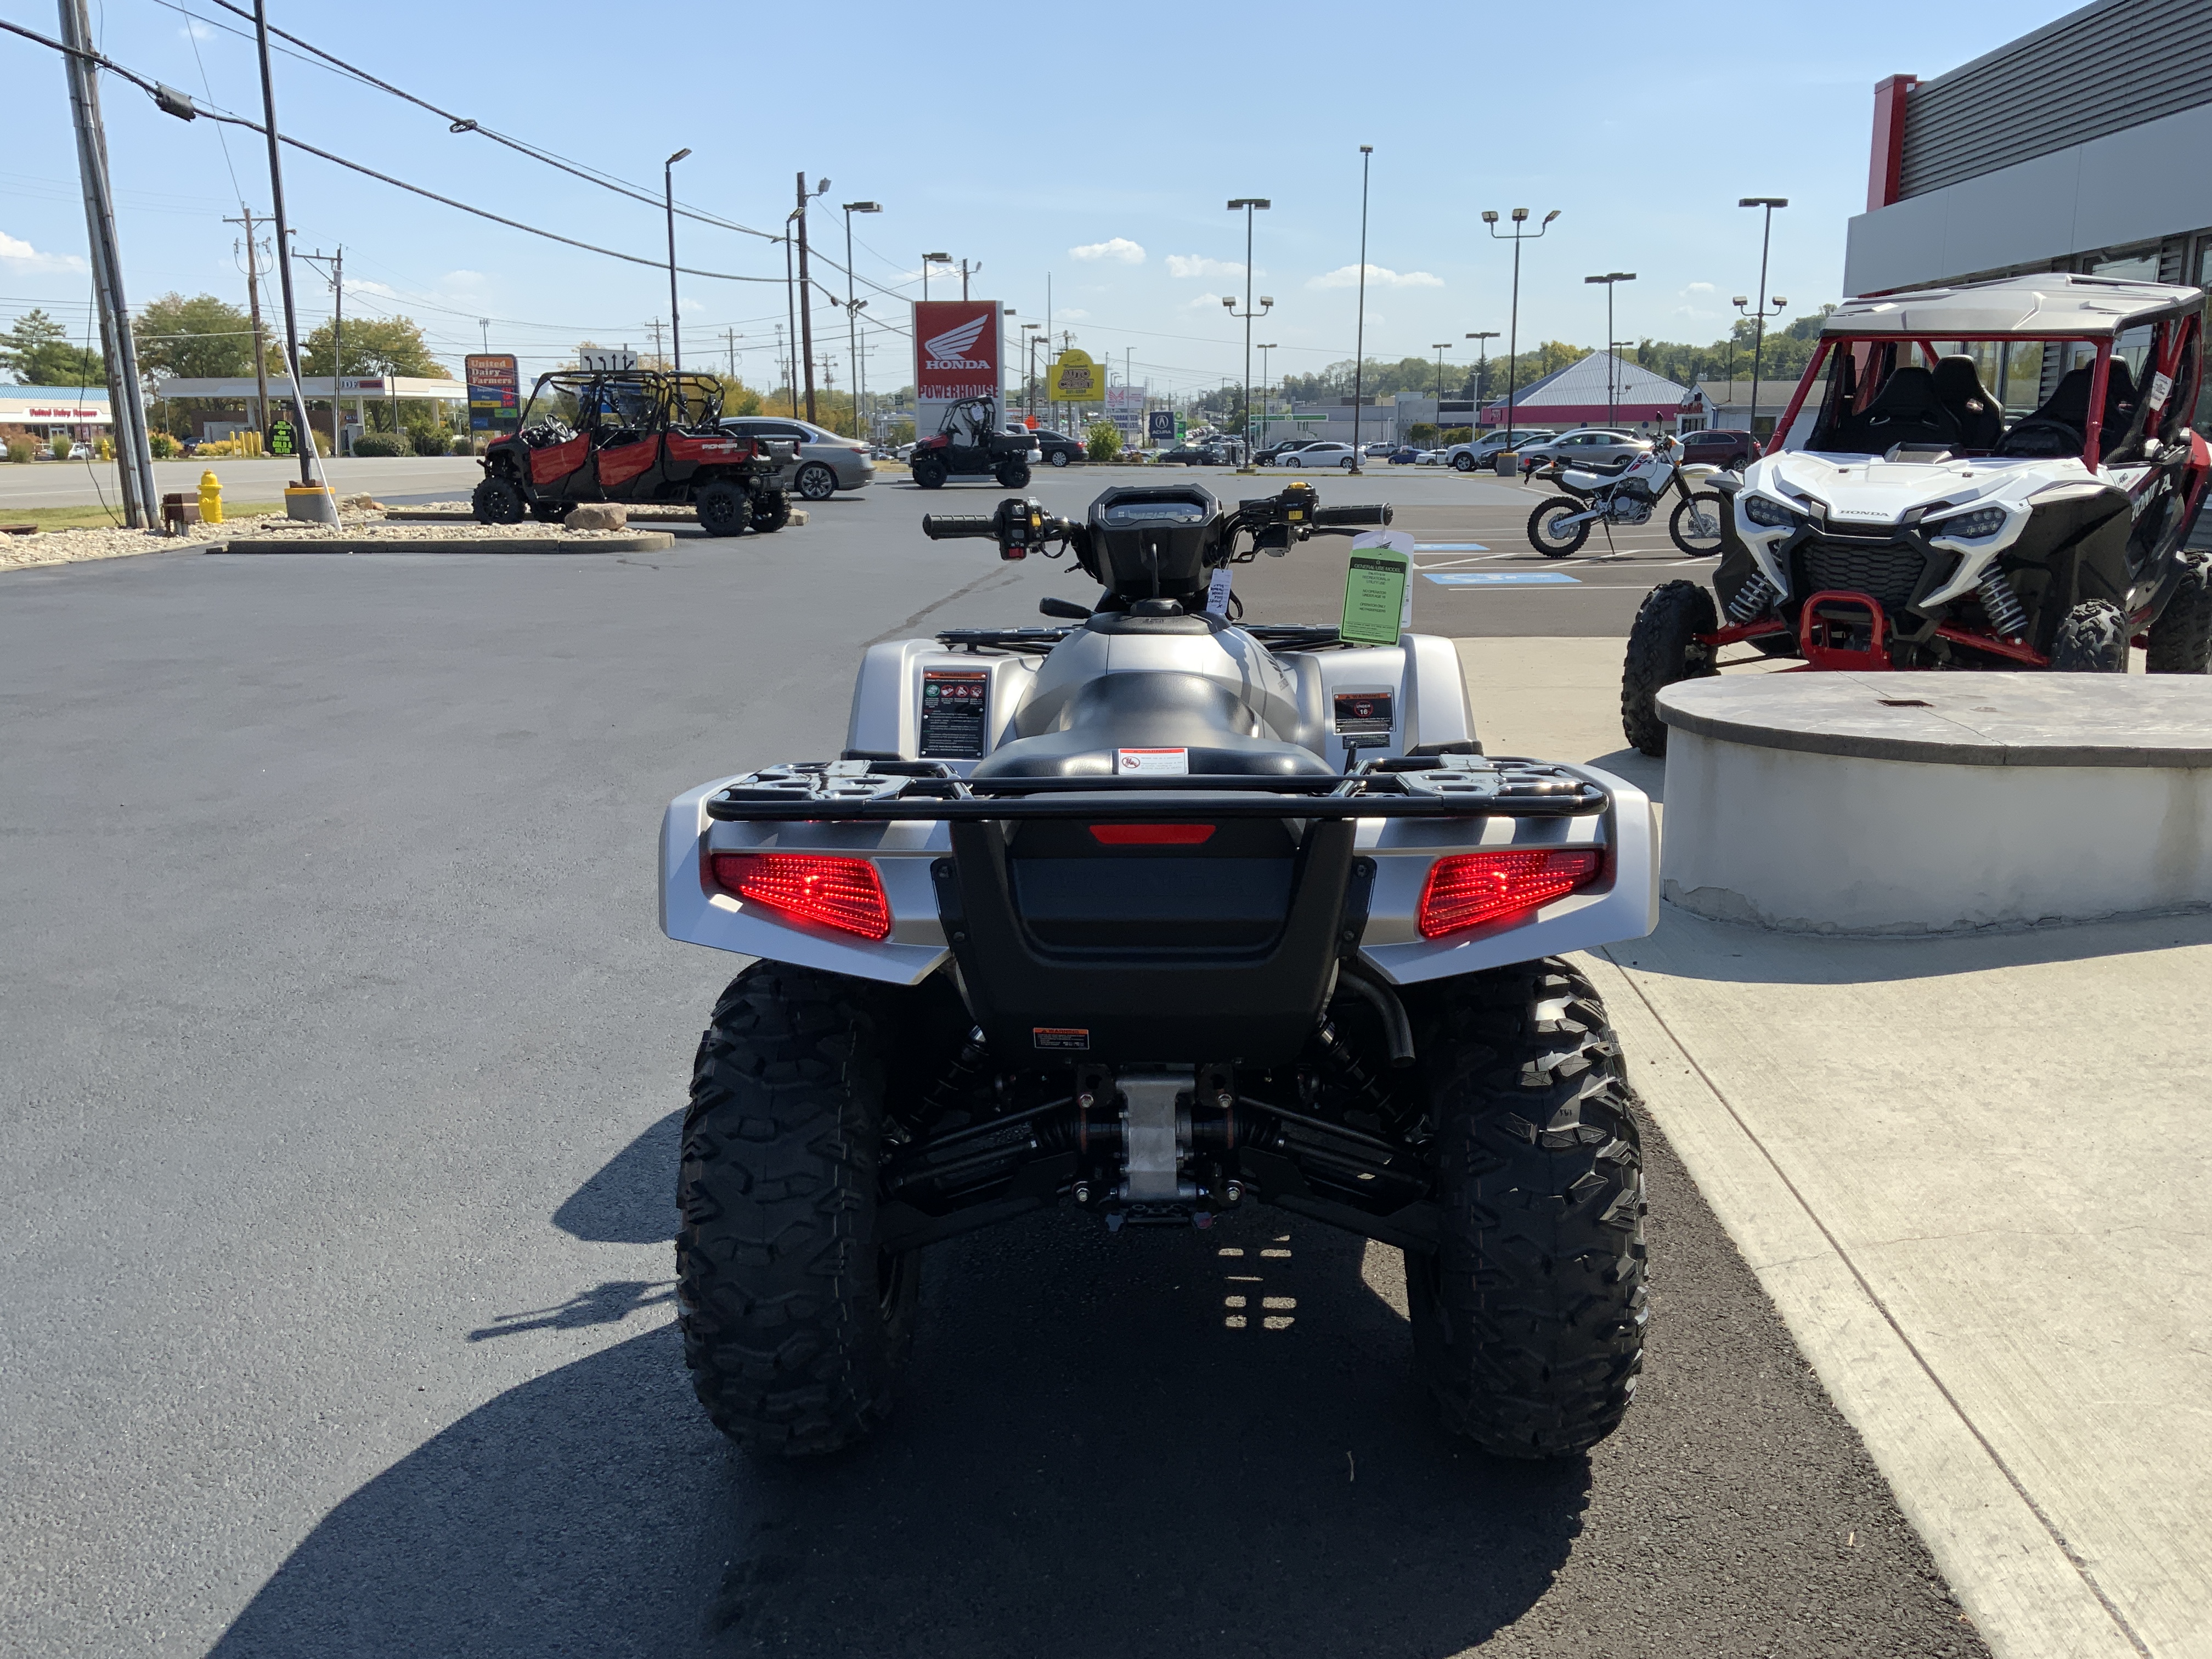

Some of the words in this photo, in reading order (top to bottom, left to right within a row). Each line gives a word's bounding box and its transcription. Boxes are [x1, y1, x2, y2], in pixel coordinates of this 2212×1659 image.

[926, 360, 991, 369] HONDA
[1062, 369, 1091, 379] AUTO
[1058, 379, 1094, 390] CREDIT
[918, 385, 998, 398] POWERHOUSE
